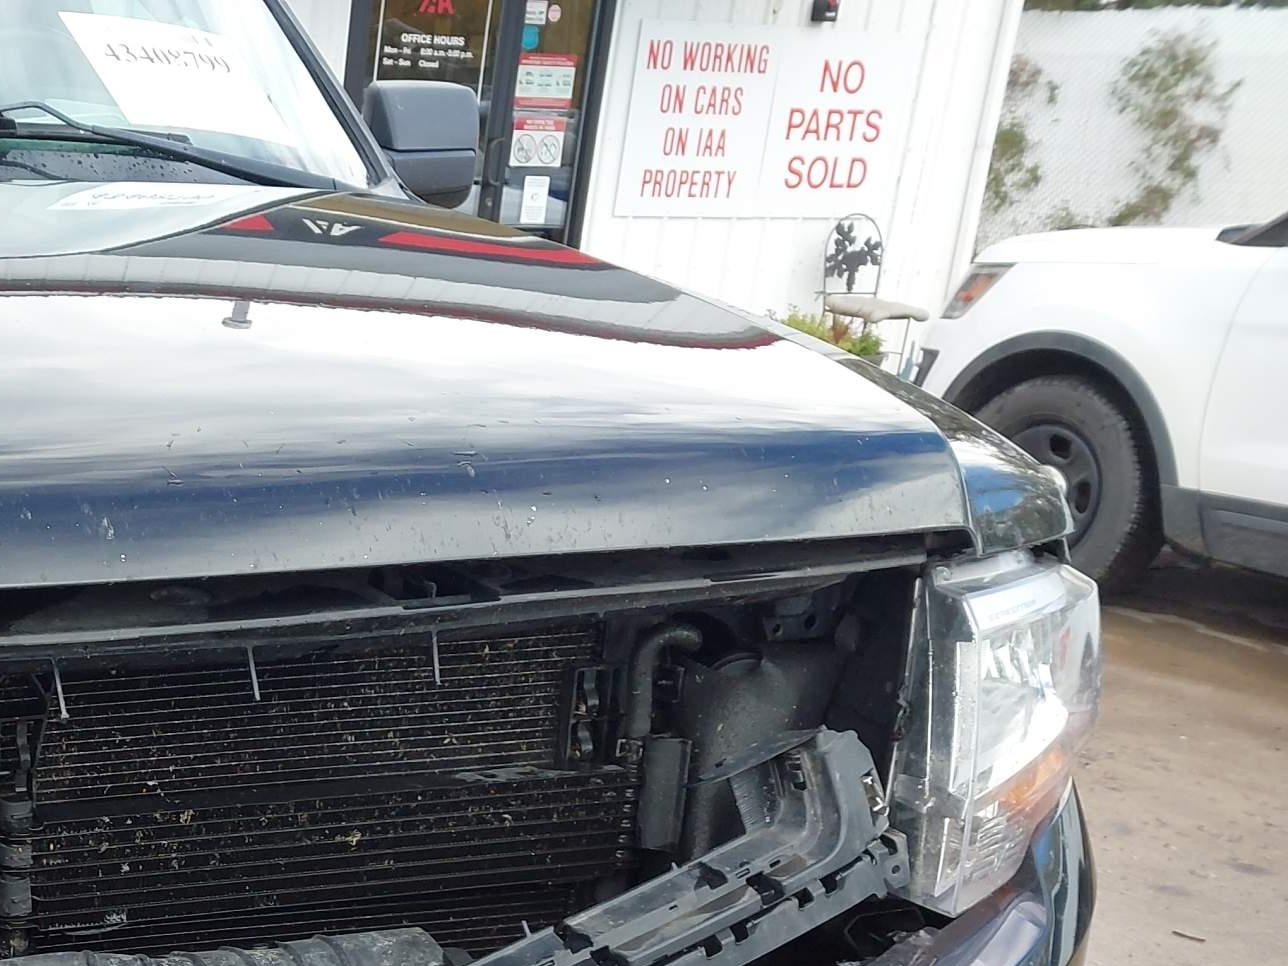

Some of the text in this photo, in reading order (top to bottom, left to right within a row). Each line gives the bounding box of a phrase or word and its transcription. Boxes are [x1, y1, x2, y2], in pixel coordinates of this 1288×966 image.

[401, 32, 466, 46] OFFICE HOURS
[647, 39, 770, 74] NO WORKING
[820, 59, 865, 94] NO
[660, 84, 744, 115] ON CARS
[785, 107, 883, 142] PARTS
[663, 127, 727, 157] ON IAA
[640, 169, 737, 198] PROPERTY
[784, 155, 868, 189] SOLD
